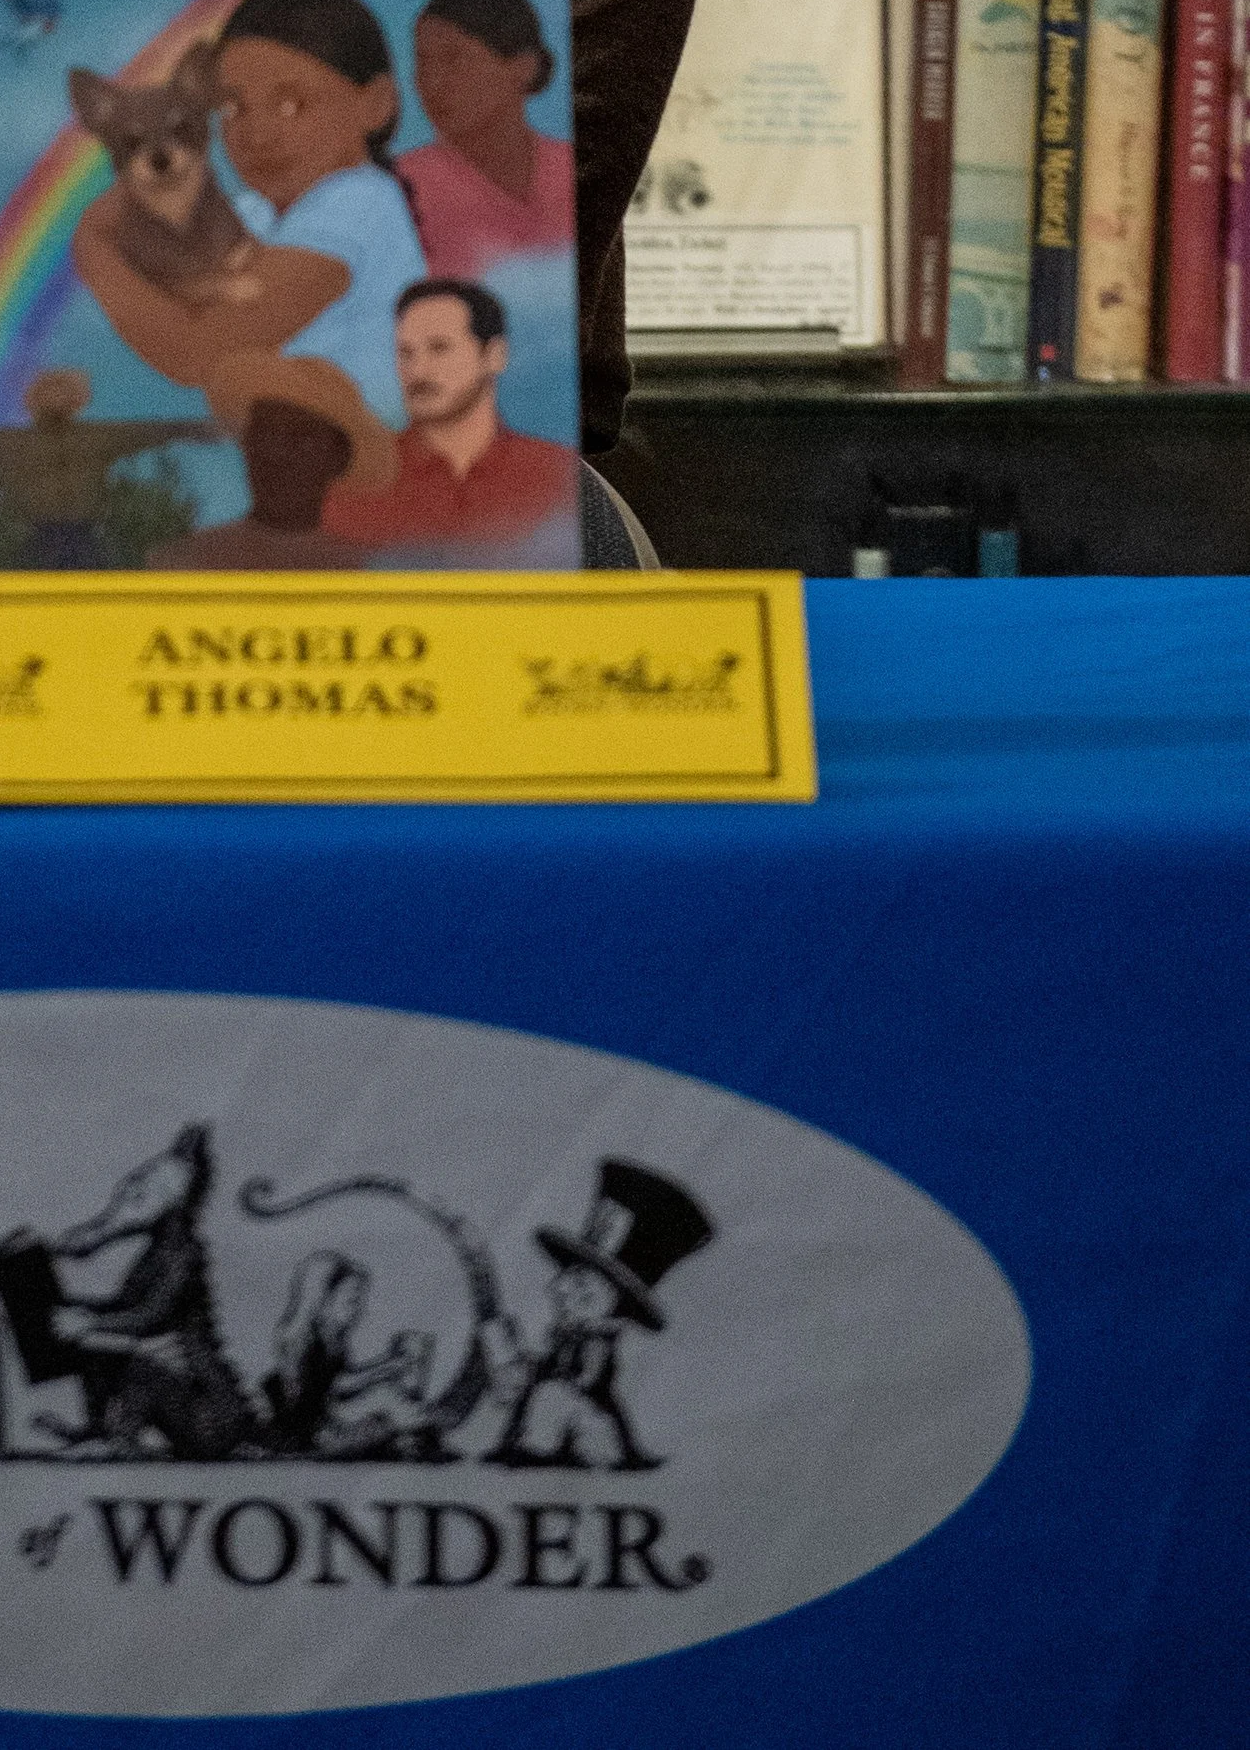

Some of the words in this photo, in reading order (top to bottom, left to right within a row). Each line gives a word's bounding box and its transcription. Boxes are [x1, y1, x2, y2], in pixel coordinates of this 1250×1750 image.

[1193, 11, 1218, 47] IN
[1042, 30, 1080, 140] American
[1188, 58, 1216, 180] FRANCE
[137, 623, 429, 669] ANGELO
[132, 678, 439, 719] THOMAS
